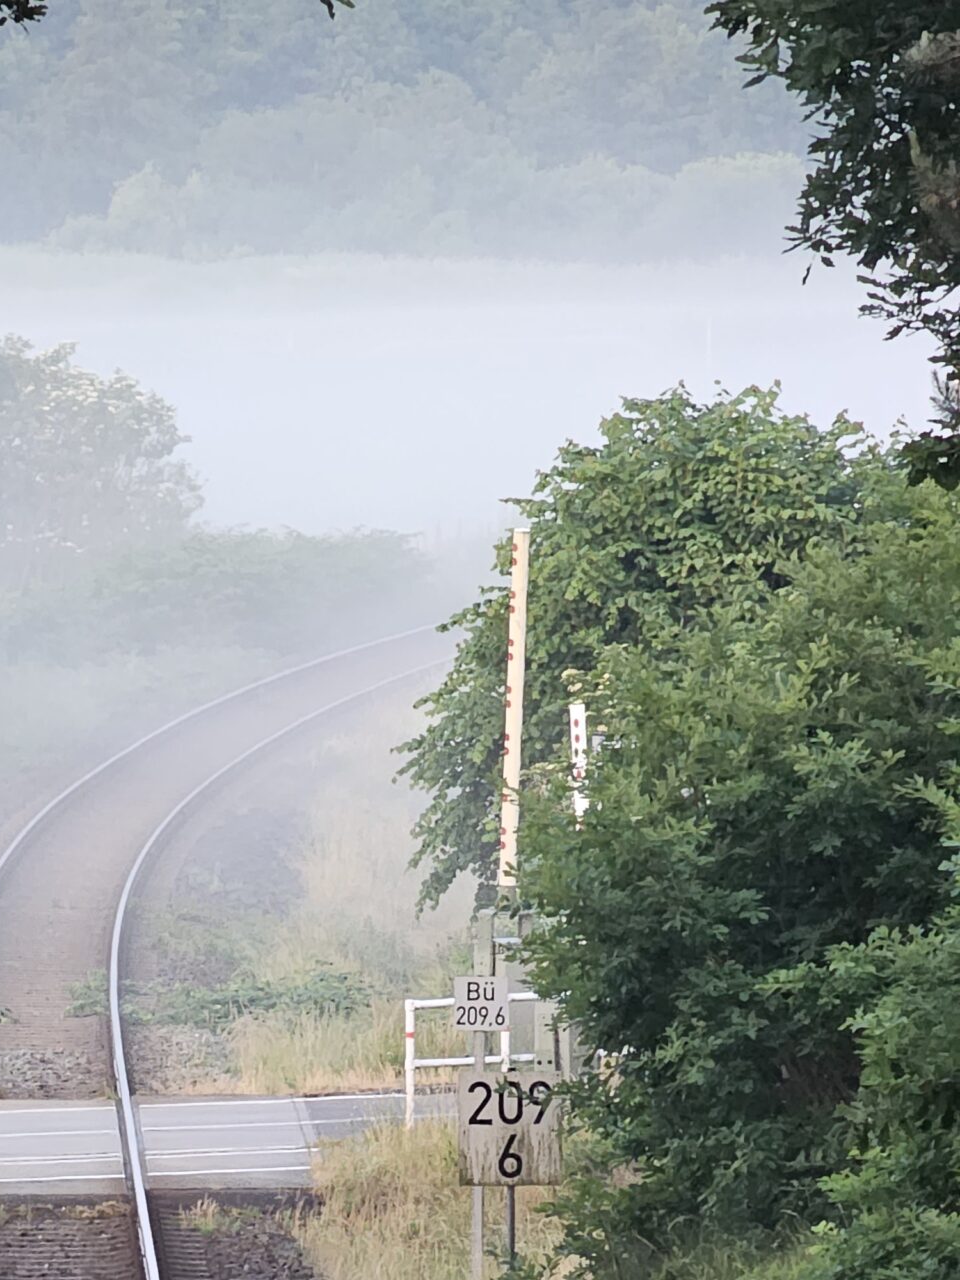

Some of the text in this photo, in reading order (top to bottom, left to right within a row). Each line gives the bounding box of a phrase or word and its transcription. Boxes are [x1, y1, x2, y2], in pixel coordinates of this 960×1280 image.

[467, 981, 495, 1001] Bü
[456, 1006, 505, 1026] 209,6
[468, 1081, 553, 1126] 209
[498, 1134, 523, 1178] 6
